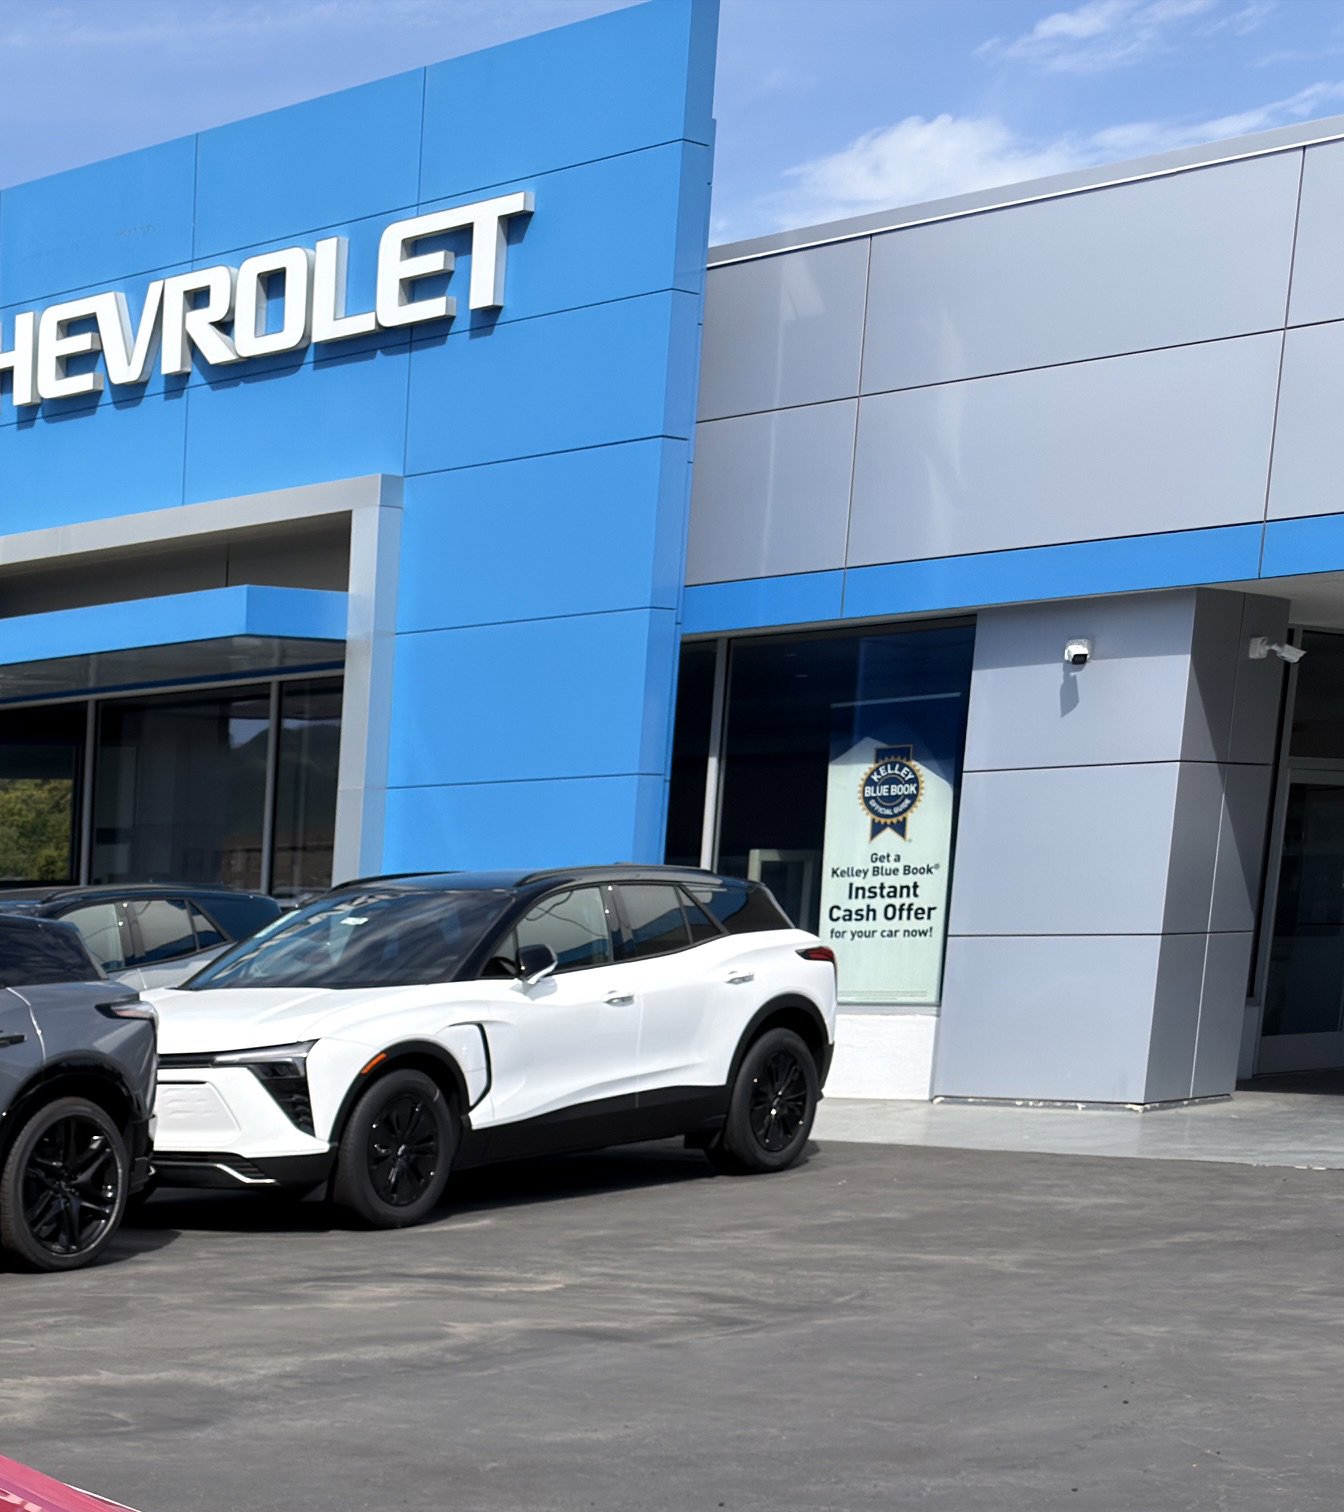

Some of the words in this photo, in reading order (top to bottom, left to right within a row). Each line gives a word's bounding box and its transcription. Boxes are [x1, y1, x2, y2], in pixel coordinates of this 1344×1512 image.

[870, 763, 915, 782] KELLEY
[864, 785, 889, 797] BLUE
[890, 783, 917, 796] BOOK
[870, 853, 891, 863] Get
[893, 854, 901, 863] a
[831, 866, 869, 879] Kelley
[872, 865, 900, 877] Blue
[848, 881, 920, 900] Instant
[828, 904, 877, 922] Cash
[883, 903, 938, 921] Offer
[830, 928, 847, 939] for
[850, 929, 878, 941] your
[880, 929, 900, 938] car
[903, 926, 934, 938] now!
